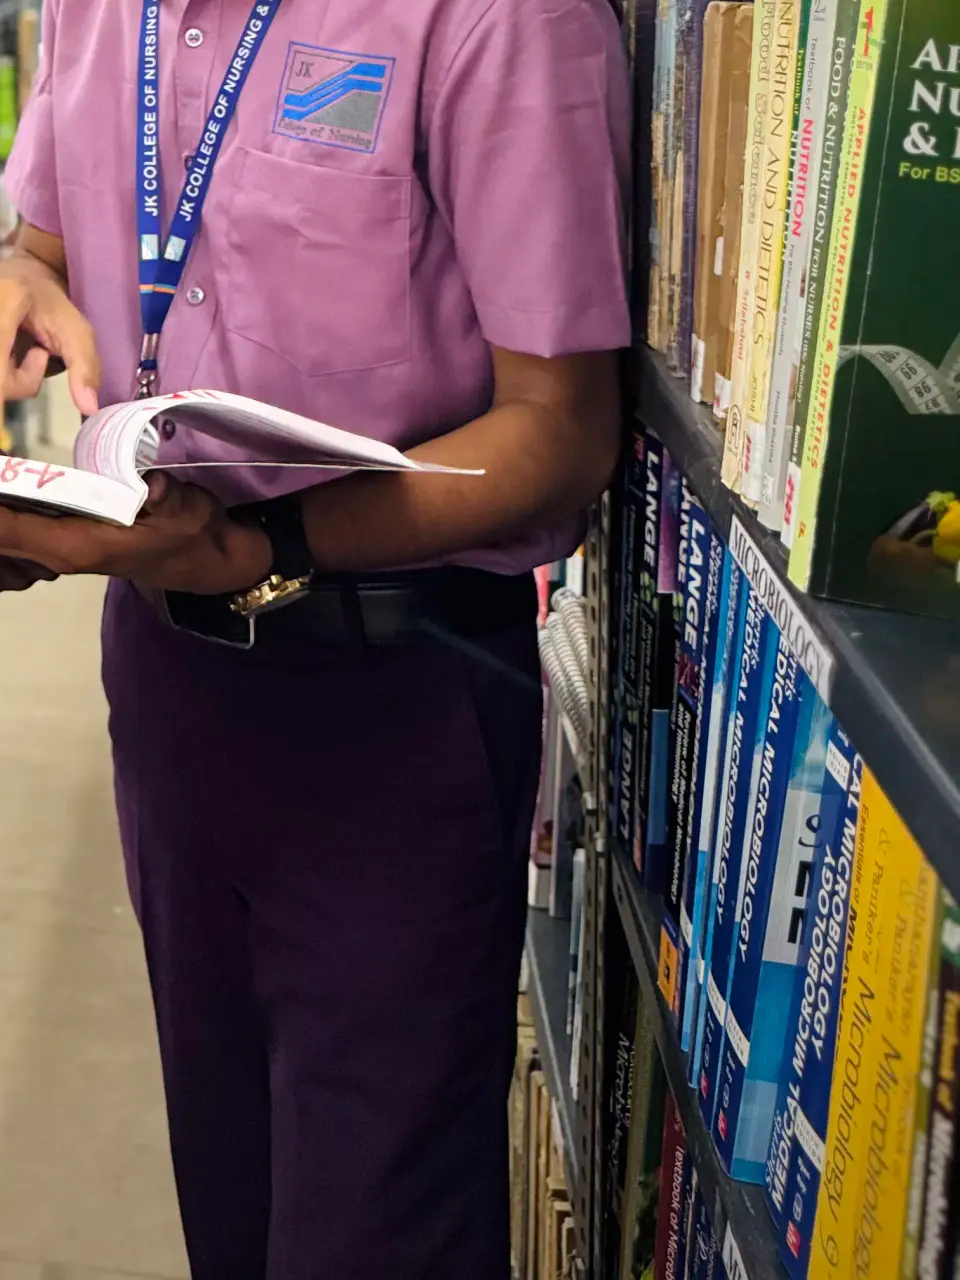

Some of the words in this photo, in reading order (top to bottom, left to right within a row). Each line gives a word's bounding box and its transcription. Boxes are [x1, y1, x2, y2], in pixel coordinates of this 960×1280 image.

[144, 6, 158, 80] NURSING
[256, 4, 270, 17] &
[223, 19, 263, 94] NURSING
[295, 61, 314, 78] JK
[770, 2, 794, 137] NUTRITION
[805, 38, 819, 93] Textbook
[831, 36, 846, 98] FOOD
[144, 85, 156, 108] OF
[213, 95, 231, 119] OF
[804, 95, 813, 110] of
[828, 102, 839, 116] &
[143, 111, 157, 191] COLLEGE
[186, 121, 221, 199] COLLEGE
[764, 147, 782, 210] AND
[791, 118, 815, 238] NUTRITION
[847, 107, 867, 199] APPLIED
[899, 162, 929, 180] For
[903, 122, 939, 157] &
[144, 195, 159, 217] JK
[178, 198, 197, 223] JK
[815, 124, 837, 244] NUTRITION
[754, 220, 775, 346] DIETETICS
[810, 247, 821, 276] FOR
[829, 207, 852, 331] NUTRITION
[804, 282, 817, 339] NURSES
[826, 339, 834, 353] &
[749, 376, 758, 413] JOSHI
[811, 364, 831, 469] DIETETICS
[644, 450, 659, 567] LANGE
[678, 477, 691, 583] ANGE
[683, 518, 706, 651] LANGE
[732, 524, 826, 692] MICROBIOLOGY
[738, 587, 760, 702] MEDICAL
[767, 633, 791, 735] EDICAL
[620, 728, 634, 840] LANGE
[717, 709, 745, 925] MICROBIOLOGY
[739, 742, 776, 963] MICROBIOLOGY
[855, 803, 870, 889] Essentials
[811, 817, 857, 1061] MICROBIOLOGY
[771, 1081, 801, 1212] MEDICAL
[793, 843, 836, 1078] MICROBIOLOGY
[825, 976, 876, 1222] Microbiology
[671, 1145, 686, 1211] Textbook
[765, 1110, 783, 1192] Sherris
[669, 1212, 677, 1230] of
